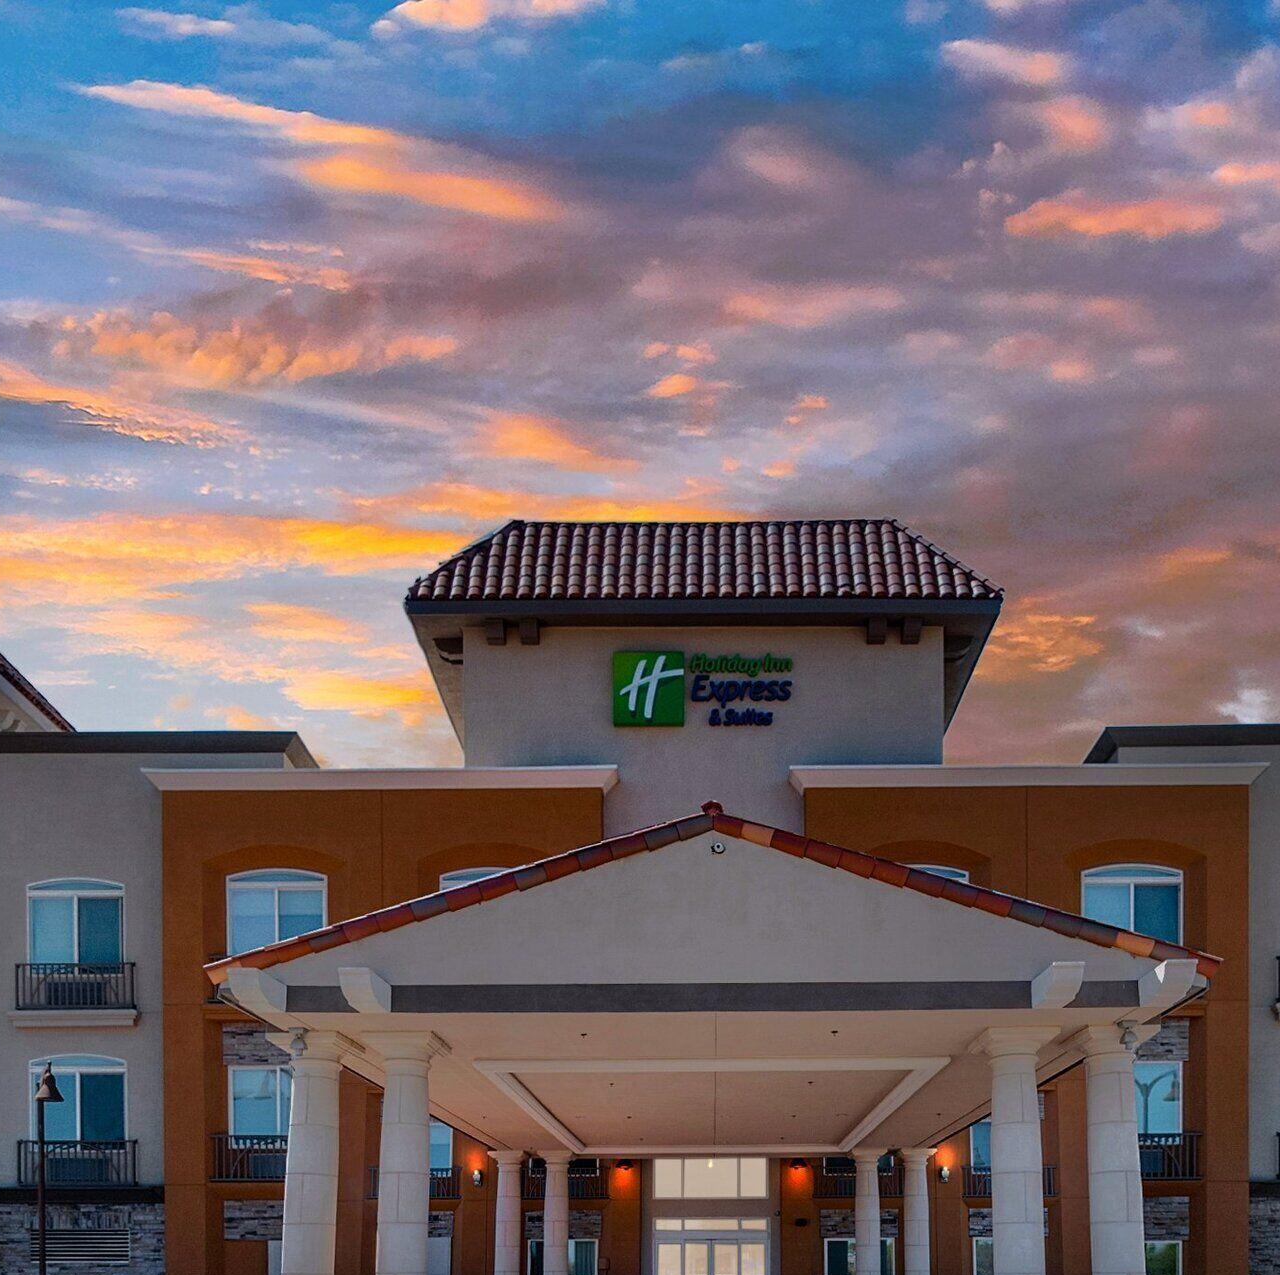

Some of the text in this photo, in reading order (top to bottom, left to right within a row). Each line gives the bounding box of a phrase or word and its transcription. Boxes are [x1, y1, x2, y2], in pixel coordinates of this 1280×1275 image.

[690, 653, 793, 677] Holiday Inn
[691, 674, 792, 708] Express
[708, 708, 773, 726] & Suites
